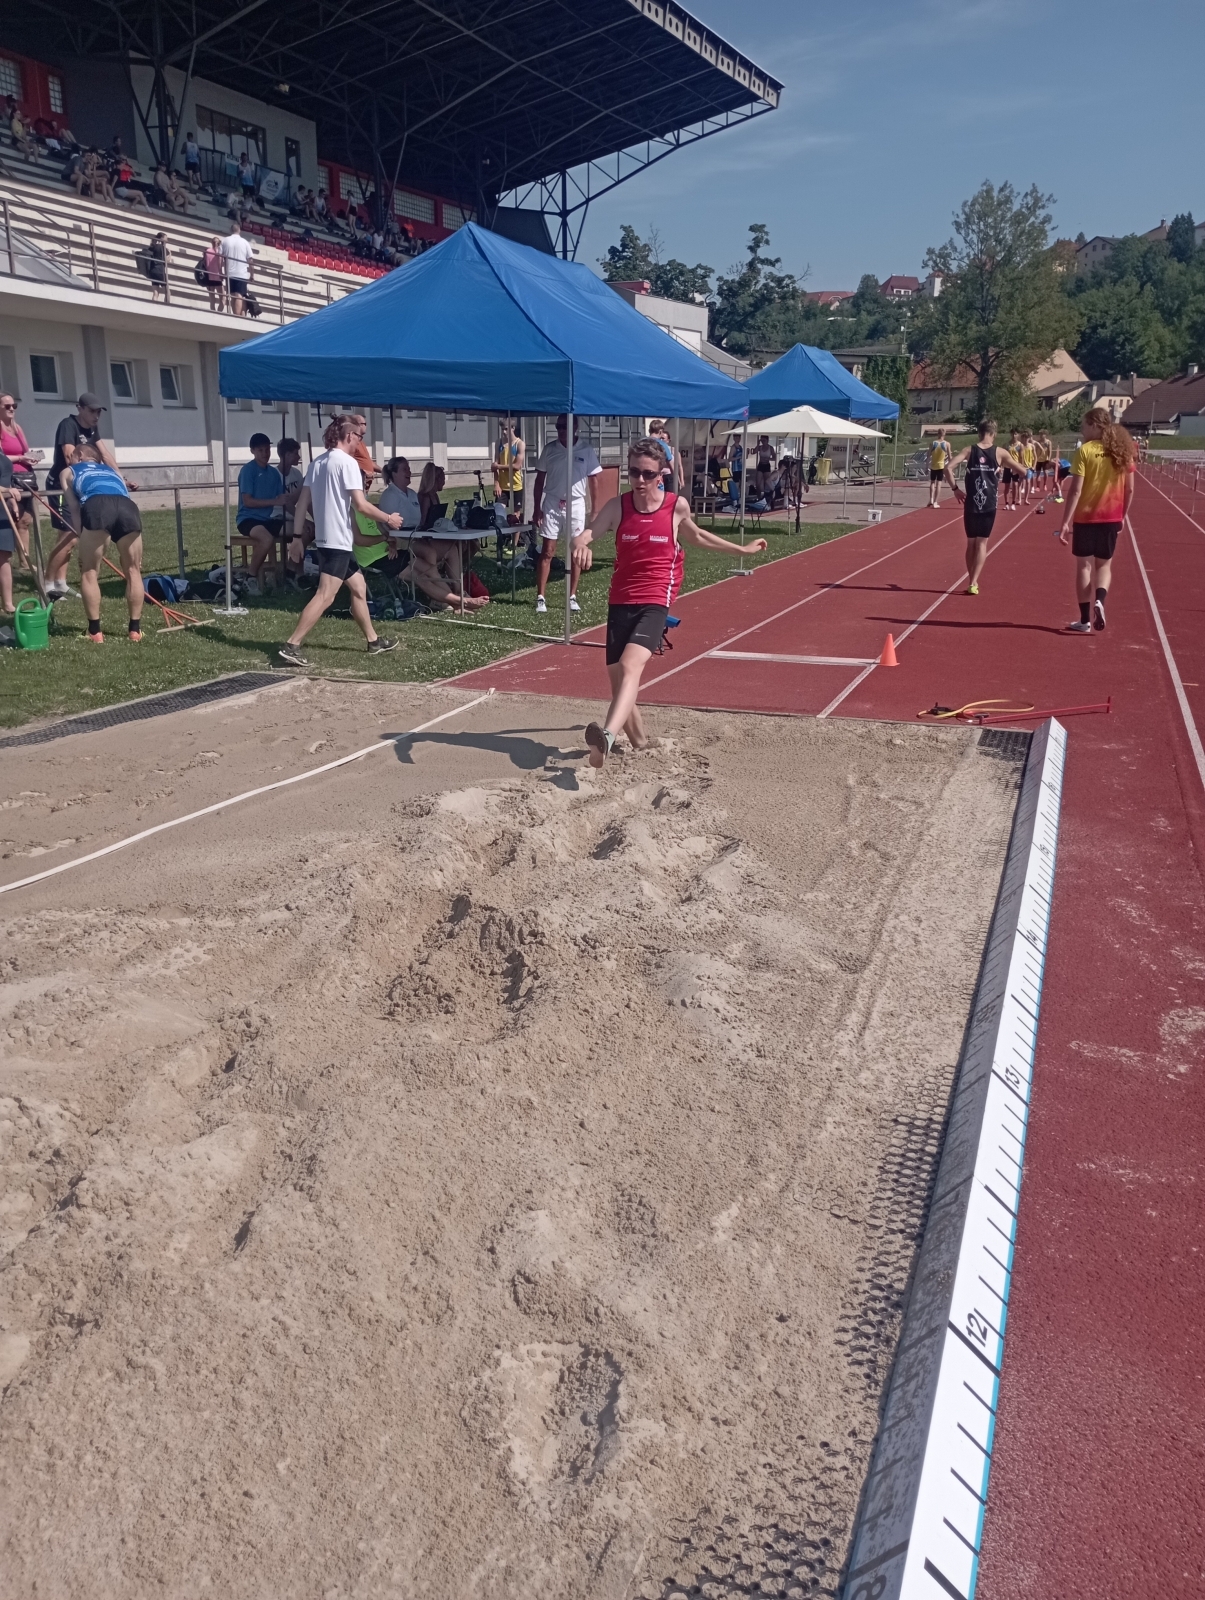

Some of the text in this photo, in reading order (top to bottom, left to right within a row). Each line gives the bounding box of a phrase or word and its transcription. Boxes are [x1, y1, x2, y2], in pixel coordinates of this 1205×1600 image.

[1004, 1066, 1020, 1090] 13
[965, 1312, 989, 1348] 12
[850, 1574, 887, 1600] 8
